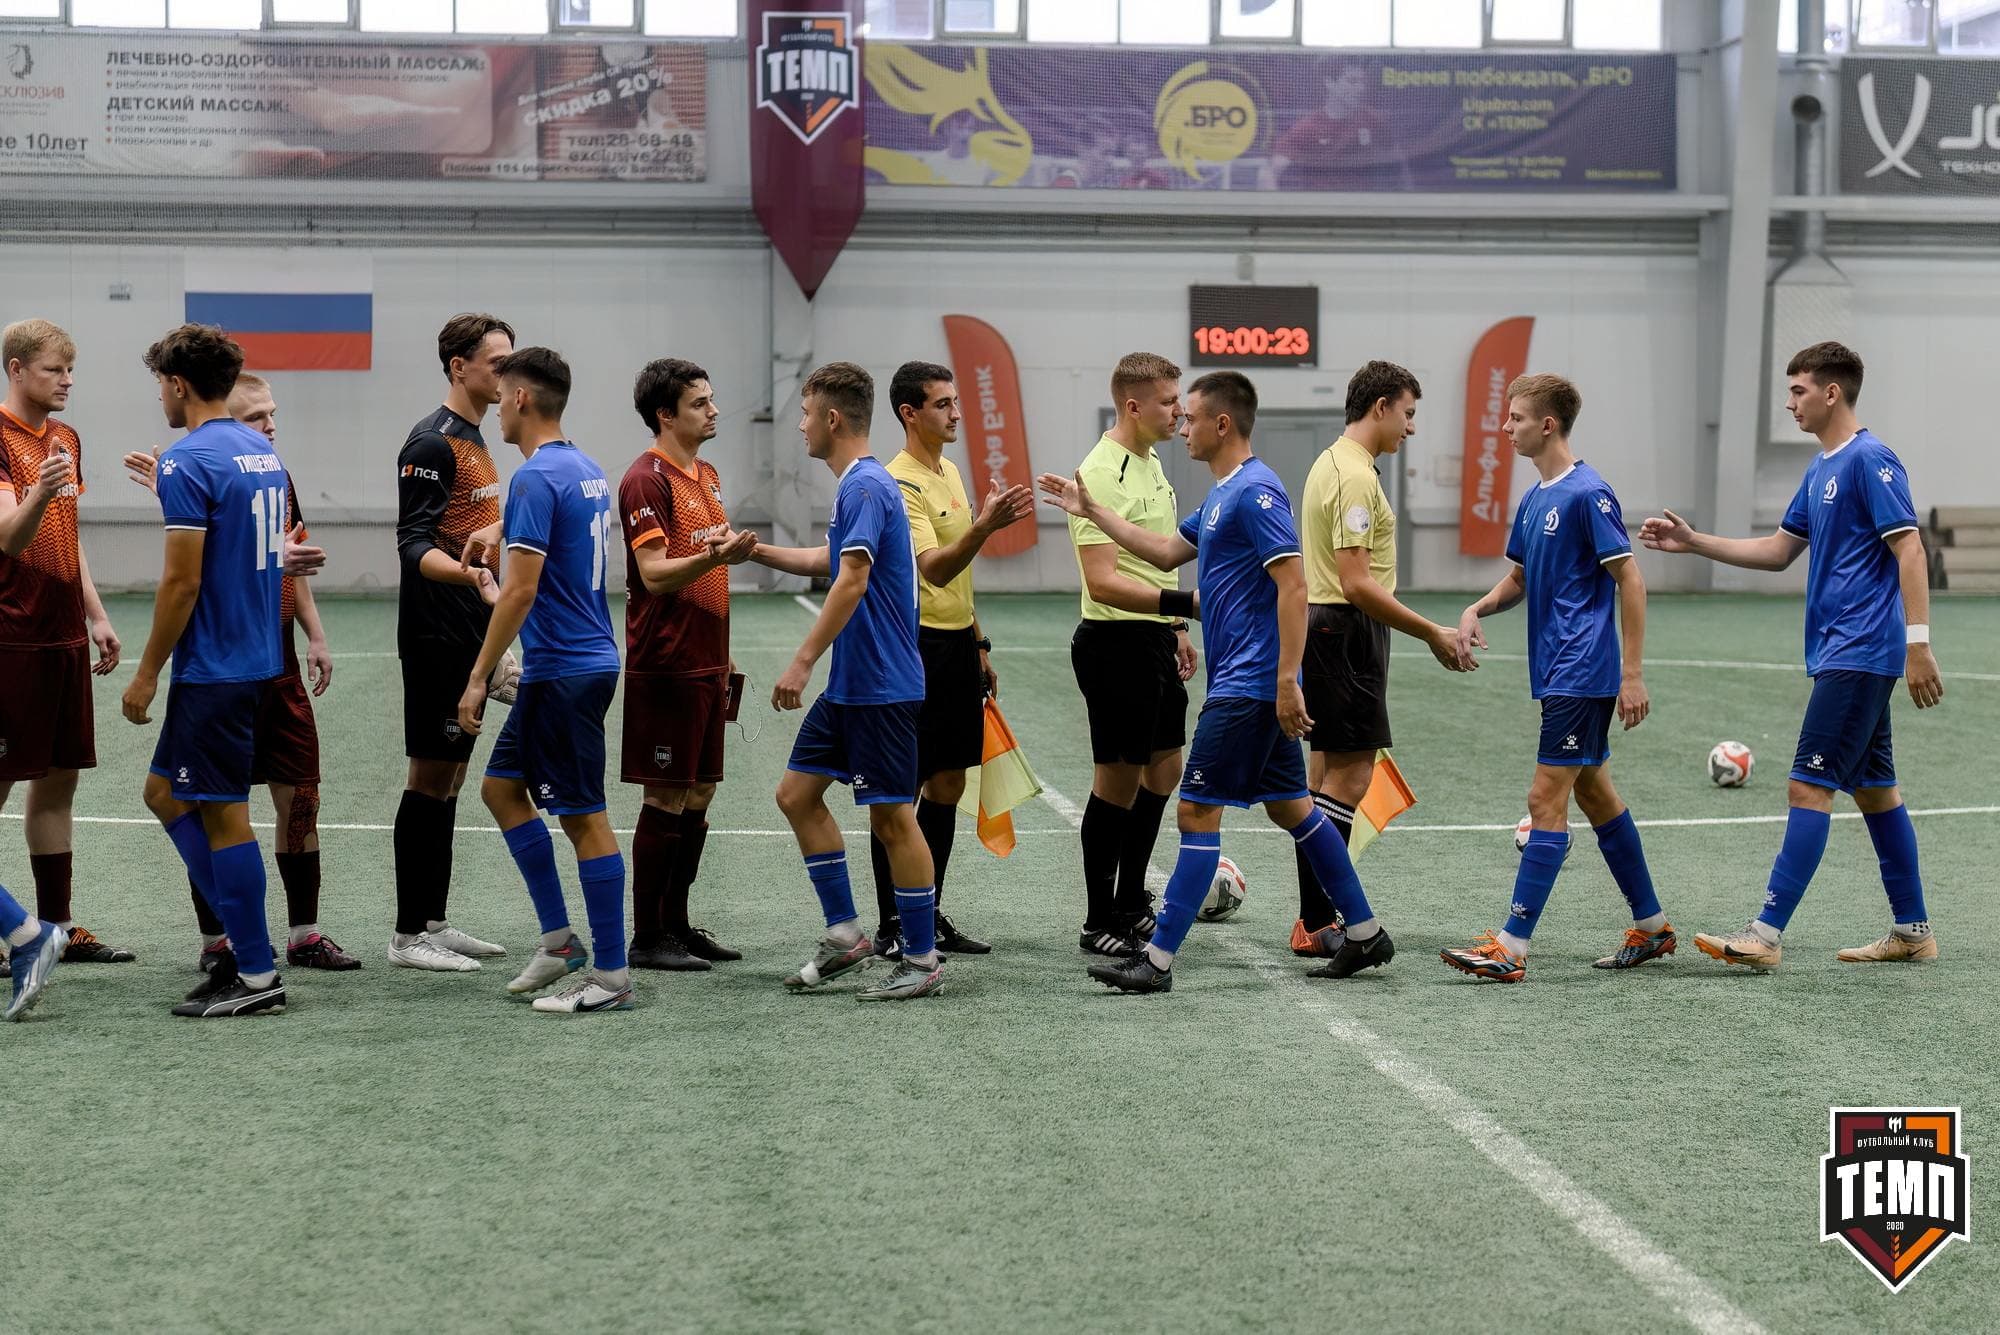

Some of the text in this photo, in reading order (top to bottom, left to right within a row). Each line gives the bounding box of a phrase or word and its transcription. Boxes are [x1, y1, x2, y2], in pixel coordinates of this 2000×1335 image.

[106, 51, 485, 71] ЛЕЧЕБНО-ОЗДОРОВИТЕЛЬНЫЙ МАССАЖ:
[766, 49, 849, 94] ТЕМП
[0, 86, 65, 99] КЛЮЗИВ
[617, 65, 673, 98] 20%
[107, 95, 195, 112] ДЕТСКИЙ
[1184, 105, 1247, 129] .БРО
[26, 133, 89, 151] 10лет
[1194, 326, 1310, 356] 19:00:23
[1472, 366, 1506, 521] Альфа Банк
[413, 466, 440, 481] ПСБ
[251, 486, 286, 571] 14
